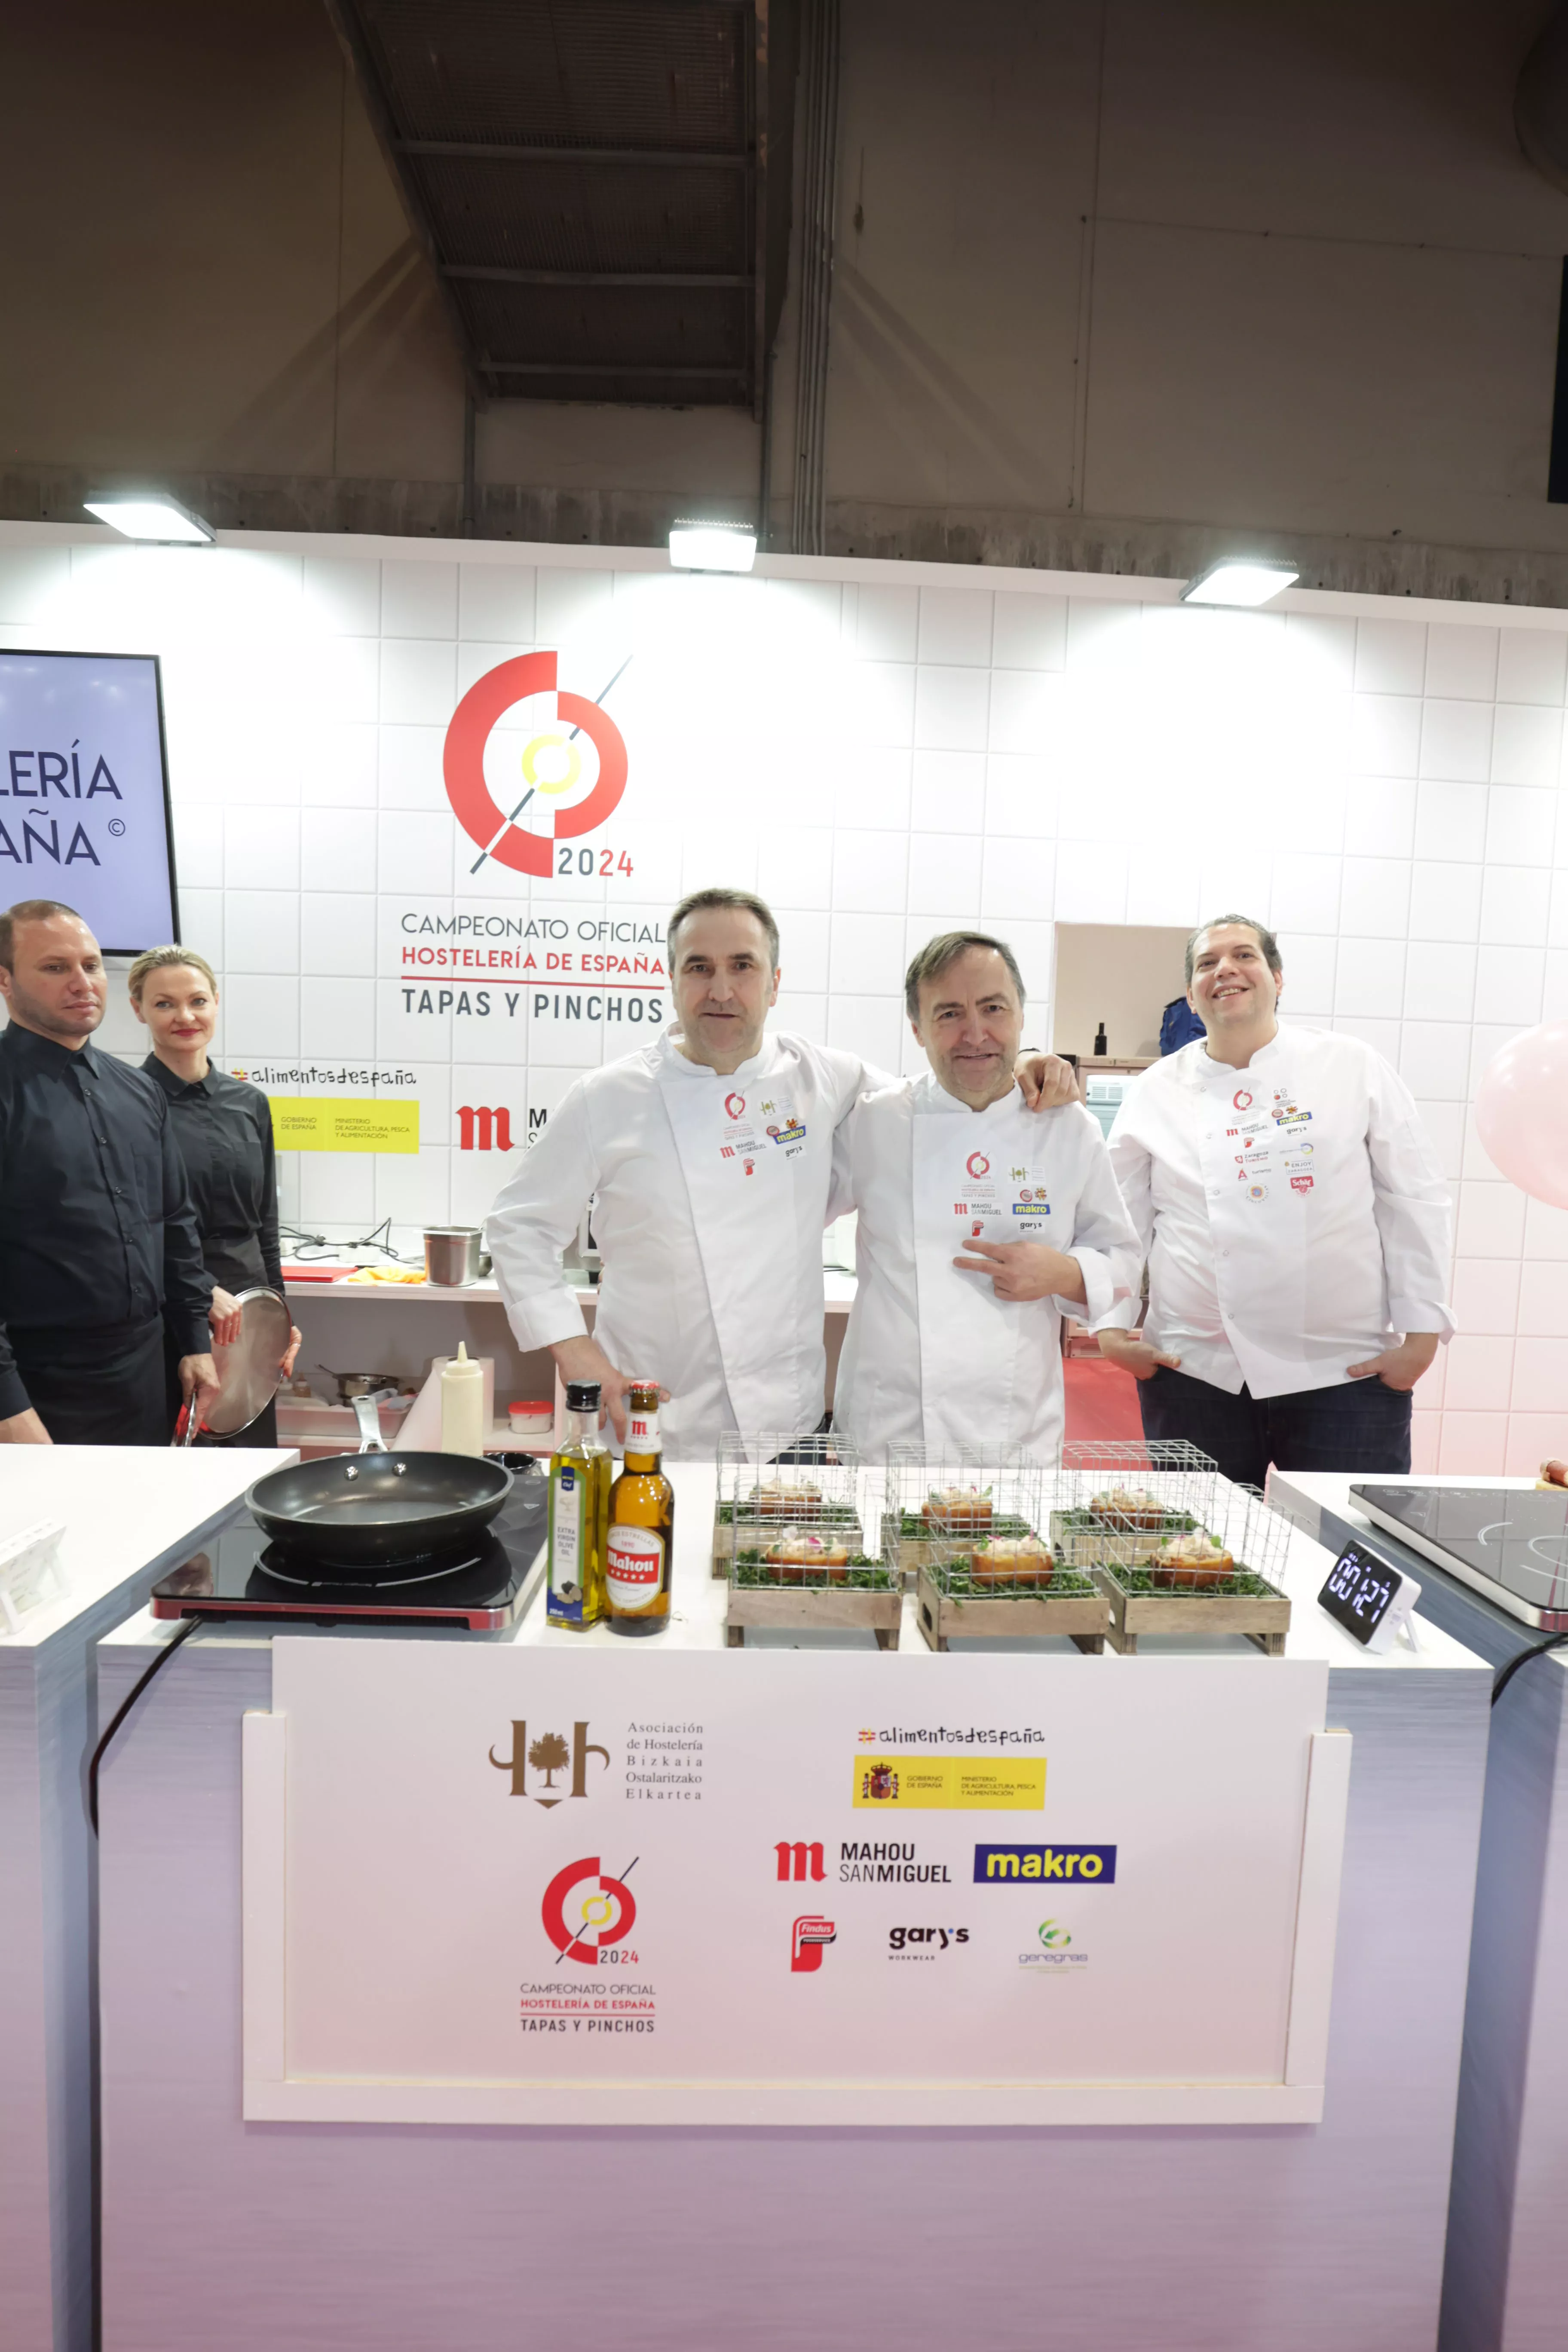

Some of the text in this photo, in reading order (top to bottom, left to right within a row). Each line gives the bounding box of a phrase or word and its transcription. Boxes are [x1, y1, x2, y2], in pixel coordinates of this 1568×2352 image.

[558, 847, 634, 877] 2024
[401, 913, 666, 943] CAMPEONATO OFICIAL
[402, 946, 665, 974] HOSTELERÍA DE ESPAÑA
[401, 989, 663, 1023] TAPAS Y PINCHOS
[1279, 1114, 1309, 1124] makro
[1241, 1123, 1259, 1131] MAHOU
[777, 1128, 804, 1143] makro
[735, 1140, 756, 1149] MAHOU
[1016, 1204, 1047, 1213] makro
[557, 1526, 576, 1535] EXTRA
[557, 1534, 576, 1542] VIRGIN
[622, 1531, 655, 1548] ESTRELLAS
[558, 1541, 574, 1550] OLIVE
[607, 1549, 654, 1573] Mahou
[627, 1722, 703, 1733] Asociación
[626, 1739, 703, 1750] de Hostelería
[627, 1755, 702, 1767] Bizkaia
[625, 1771, 702, 1784] Ostalaritzako
[626, 1788, 701, 1800] Elkartea
[841, 1843, 915, 1861] MAHOU
[987, 1849, 1103, 1878] makro
[839, 1865, 952, 1883] SANMIGUEL
[801, 1923, 832, 1933] Findus
[600, 1950, 639, 1964] 2024
[1018, 1953, 1089, 1964] geregras
[520, 1983, 656, 1995] CAMPEONATO OFICIAL
[521, 1997, 655, 2009] HOSTELERÍA DE ESPAÑA
[521, 2019, 655, 2033] TAPAS Y PINCHOS
